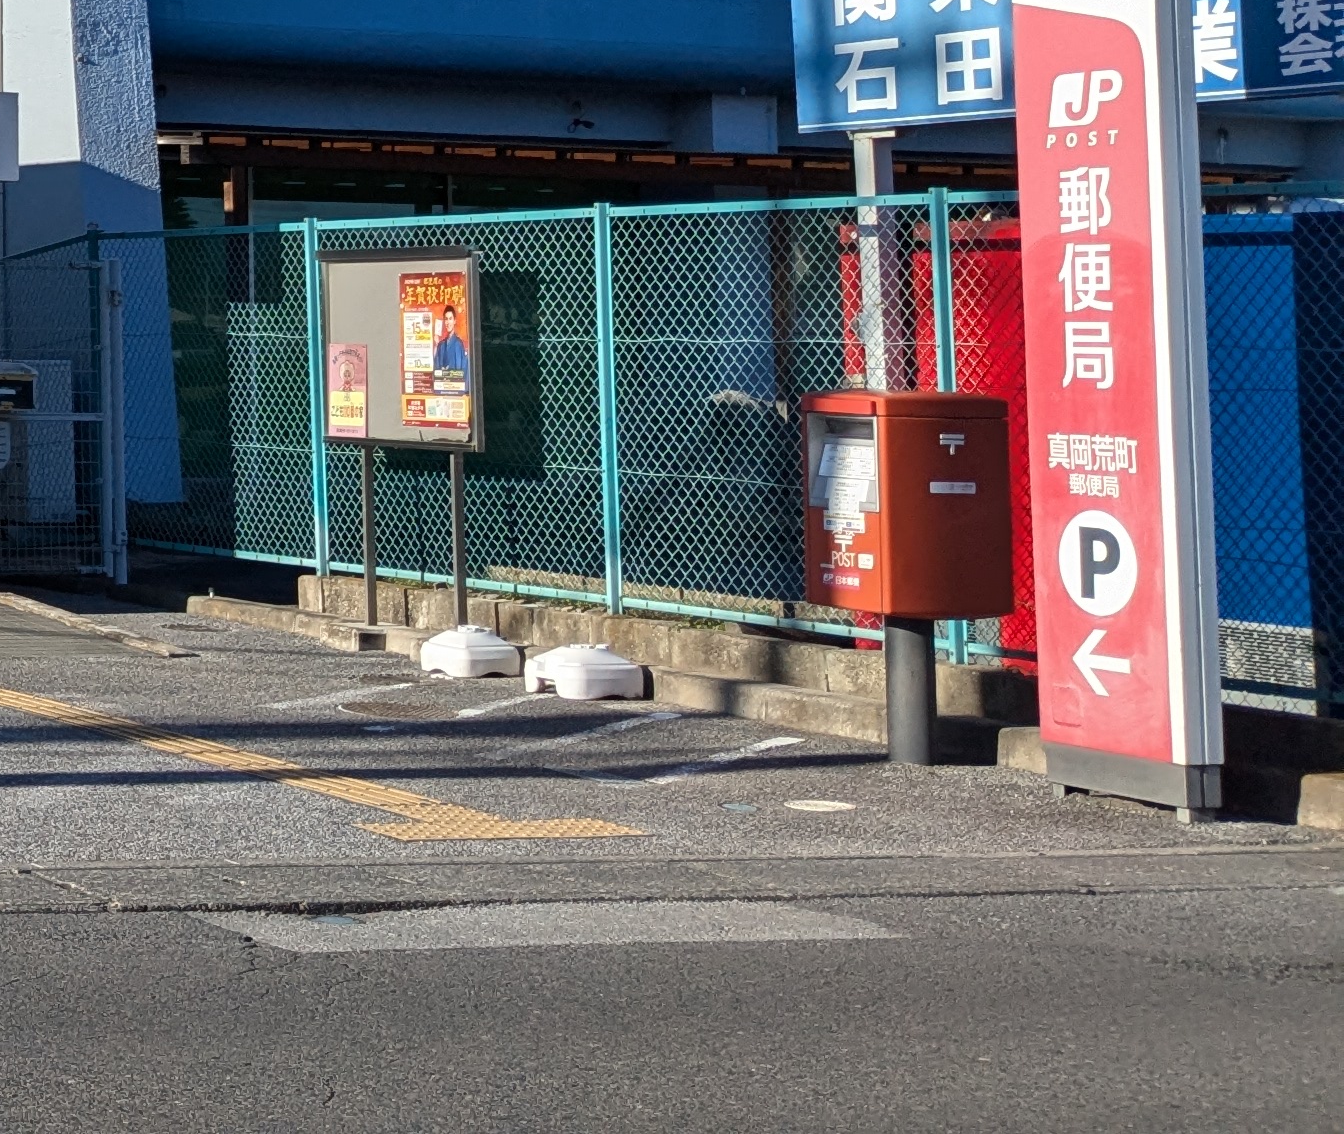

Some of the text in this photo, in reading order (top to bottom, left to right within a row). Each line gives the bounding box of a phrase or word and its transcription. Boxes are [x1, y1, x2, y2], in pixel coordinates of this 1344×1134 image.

[834, 27, 1003, 114] 石田
[1046, 129, 1119, 148] POST
[1058, 166, 1114, 389] 郵便局
[405, 285, 465, 305] 年賀状印刷
[1047, 432, 1138, 474] 真岡荒町
[1069, 473, 1120, 498] 郵便局
[832, 551, 856, 568] POST
[1078, 526, 1121, 599] P
